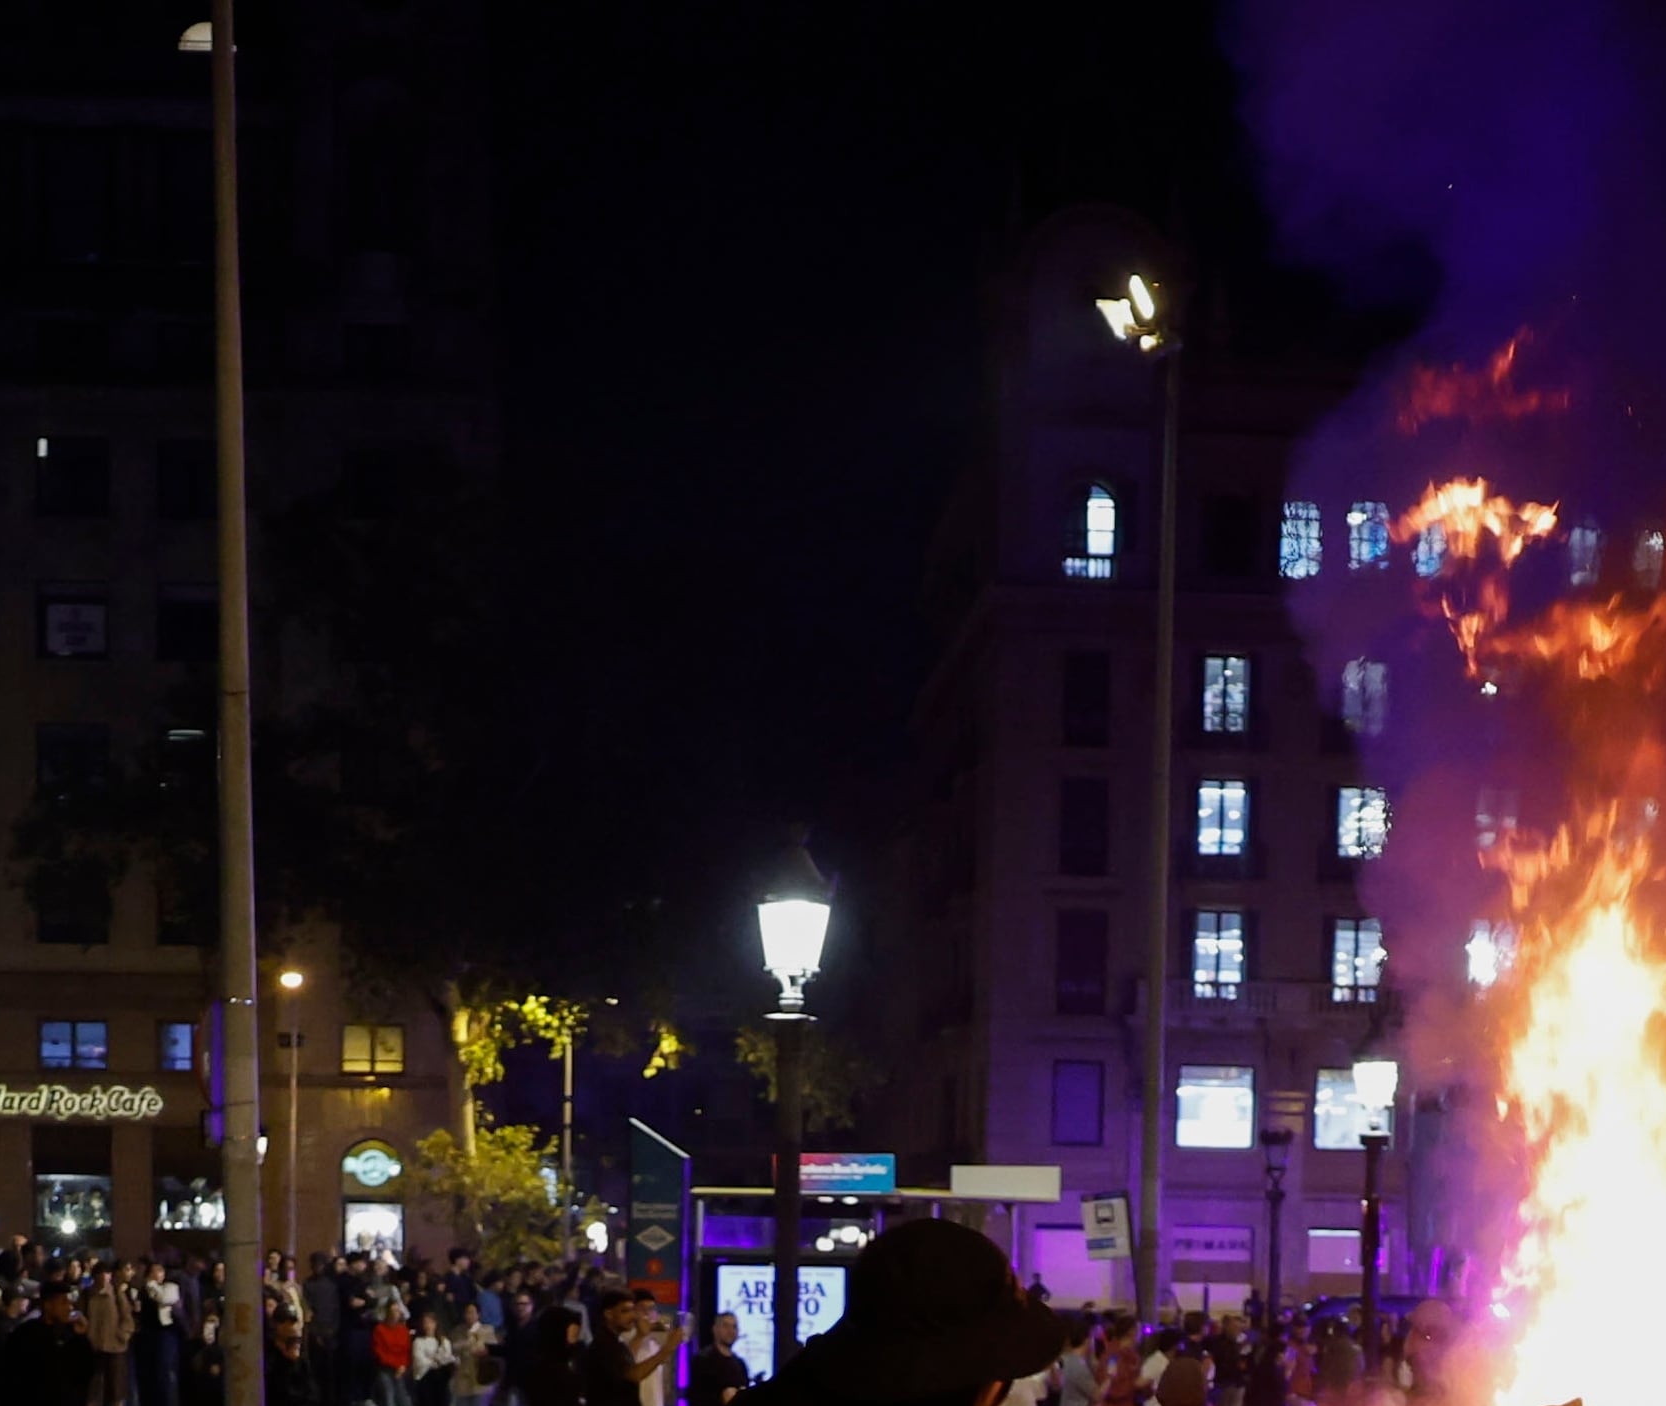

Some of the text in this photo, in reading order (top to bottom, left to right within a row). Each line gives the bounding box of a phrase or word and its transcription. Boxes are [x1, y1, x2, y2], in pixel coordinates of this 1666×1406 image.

[47, 1085, 107, 1120] Rock
[105, 1085, 164, 1120] Cafe
[737, 1280, 826, 1298] ARBA
